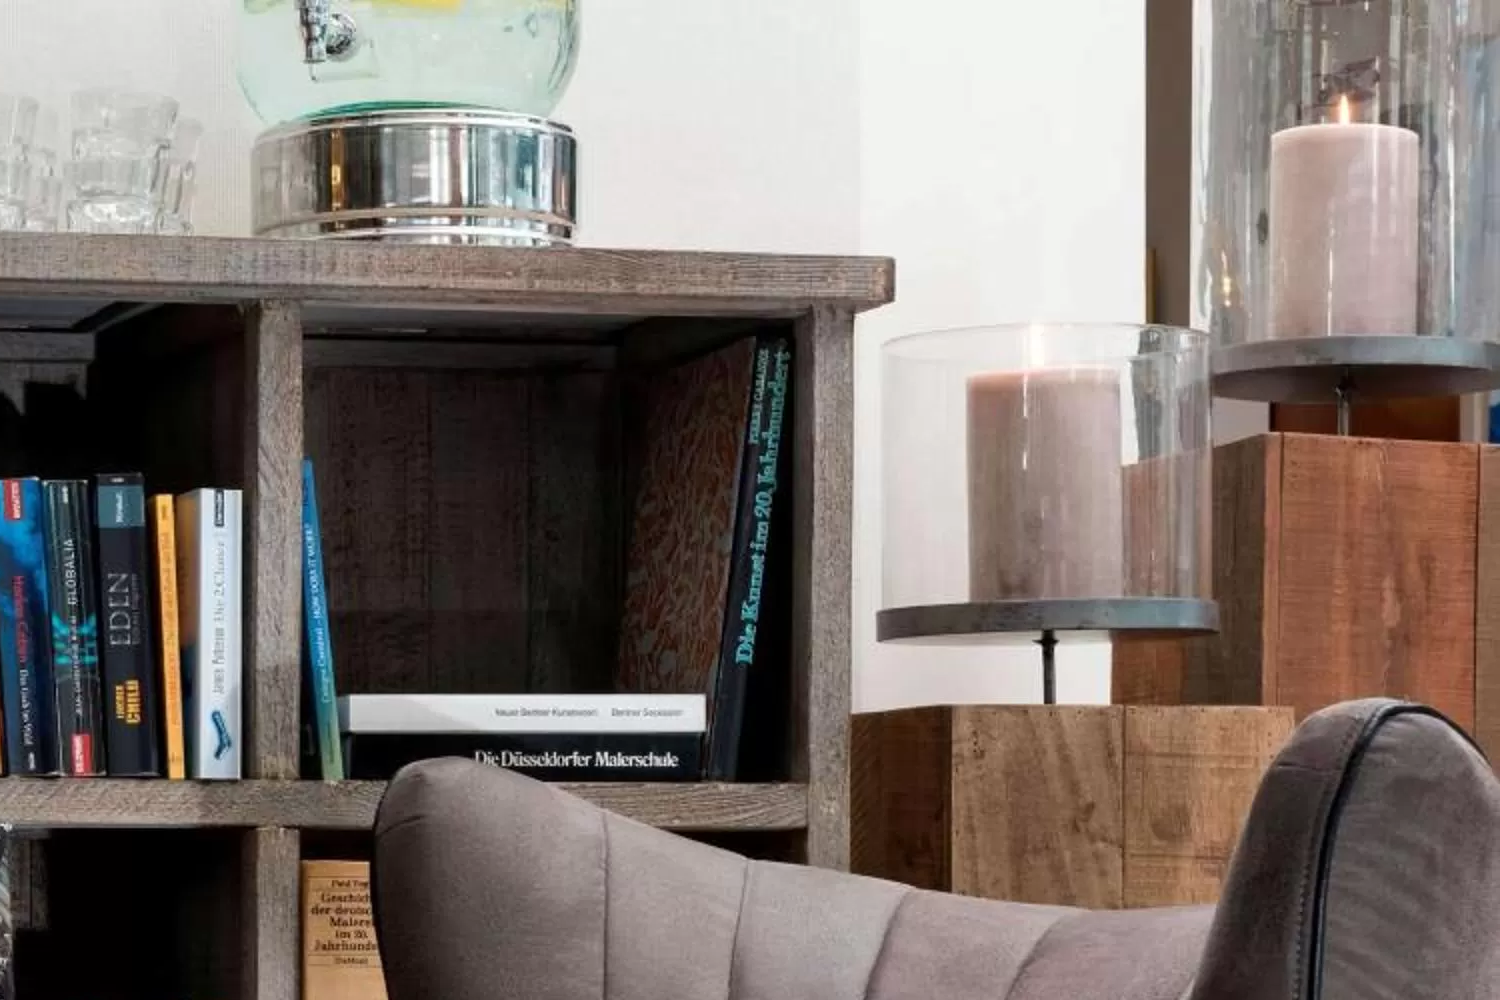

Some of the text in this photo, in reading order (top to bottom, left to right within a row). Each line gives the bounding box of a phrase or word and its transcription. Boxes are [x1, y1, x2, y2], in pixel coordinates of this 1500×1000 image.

[757, 350, 789, 491] Jahrhundert
[64, 539, 76, 604] GLOBALIA
[742, 555, 763, 620] Kunst
[109, 574, 131, 645] EDEN
[736, 624, 756, 662] Die
[127, 681, 139, 723] CHILD
[475, 750, 680, 767] Die Düsseldorfer Malerschule
[329, 916, 372, 926] Malere
[314, 940, 377, 951] Jahrhunde
